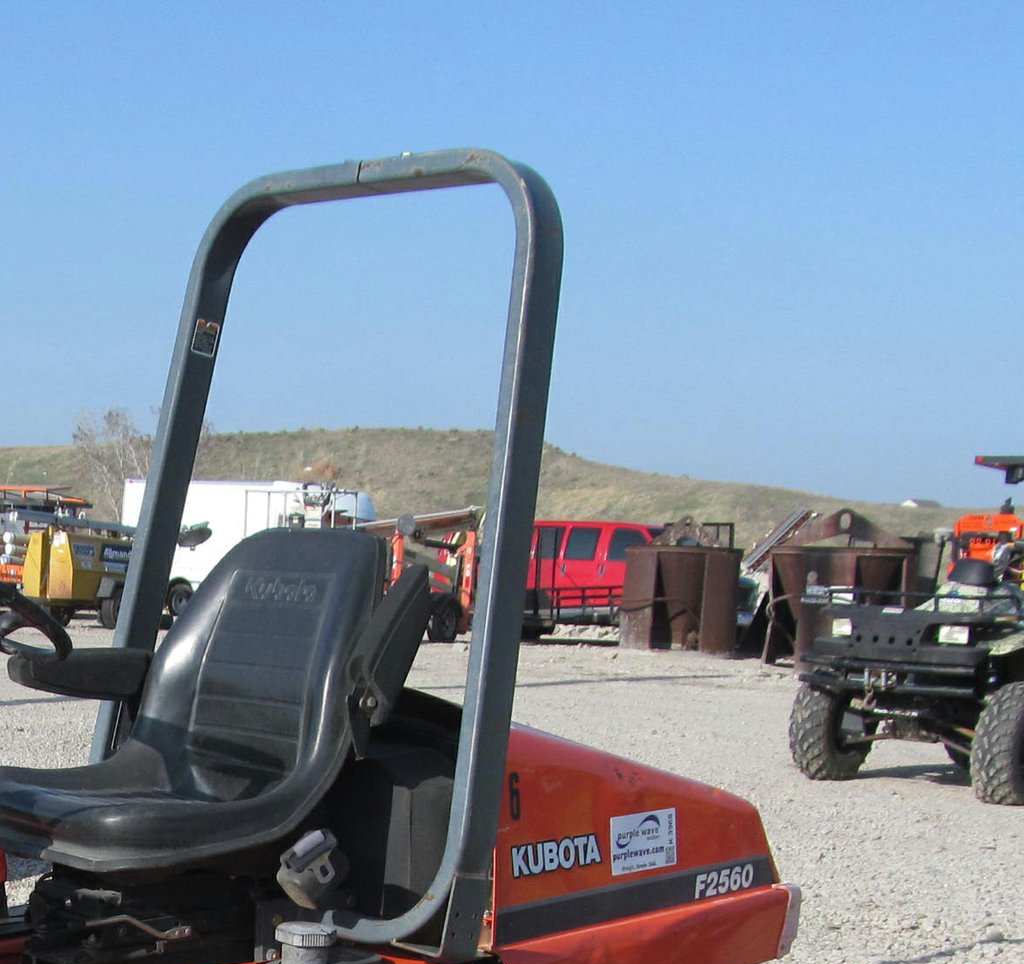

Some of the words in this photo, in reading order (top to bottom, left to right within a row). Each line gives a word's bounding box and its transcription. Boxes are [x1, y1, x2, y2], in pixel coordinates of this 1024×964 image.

[509, 772, 521, 821] 6
[617, 828, 640, 841] purple
[642, 827, 659, 836] wave
[511, 833, 602, 878] KUBOTA
[613, 845, 665, 862] purplewave.com
[695, 863, 754, 900] F2560
